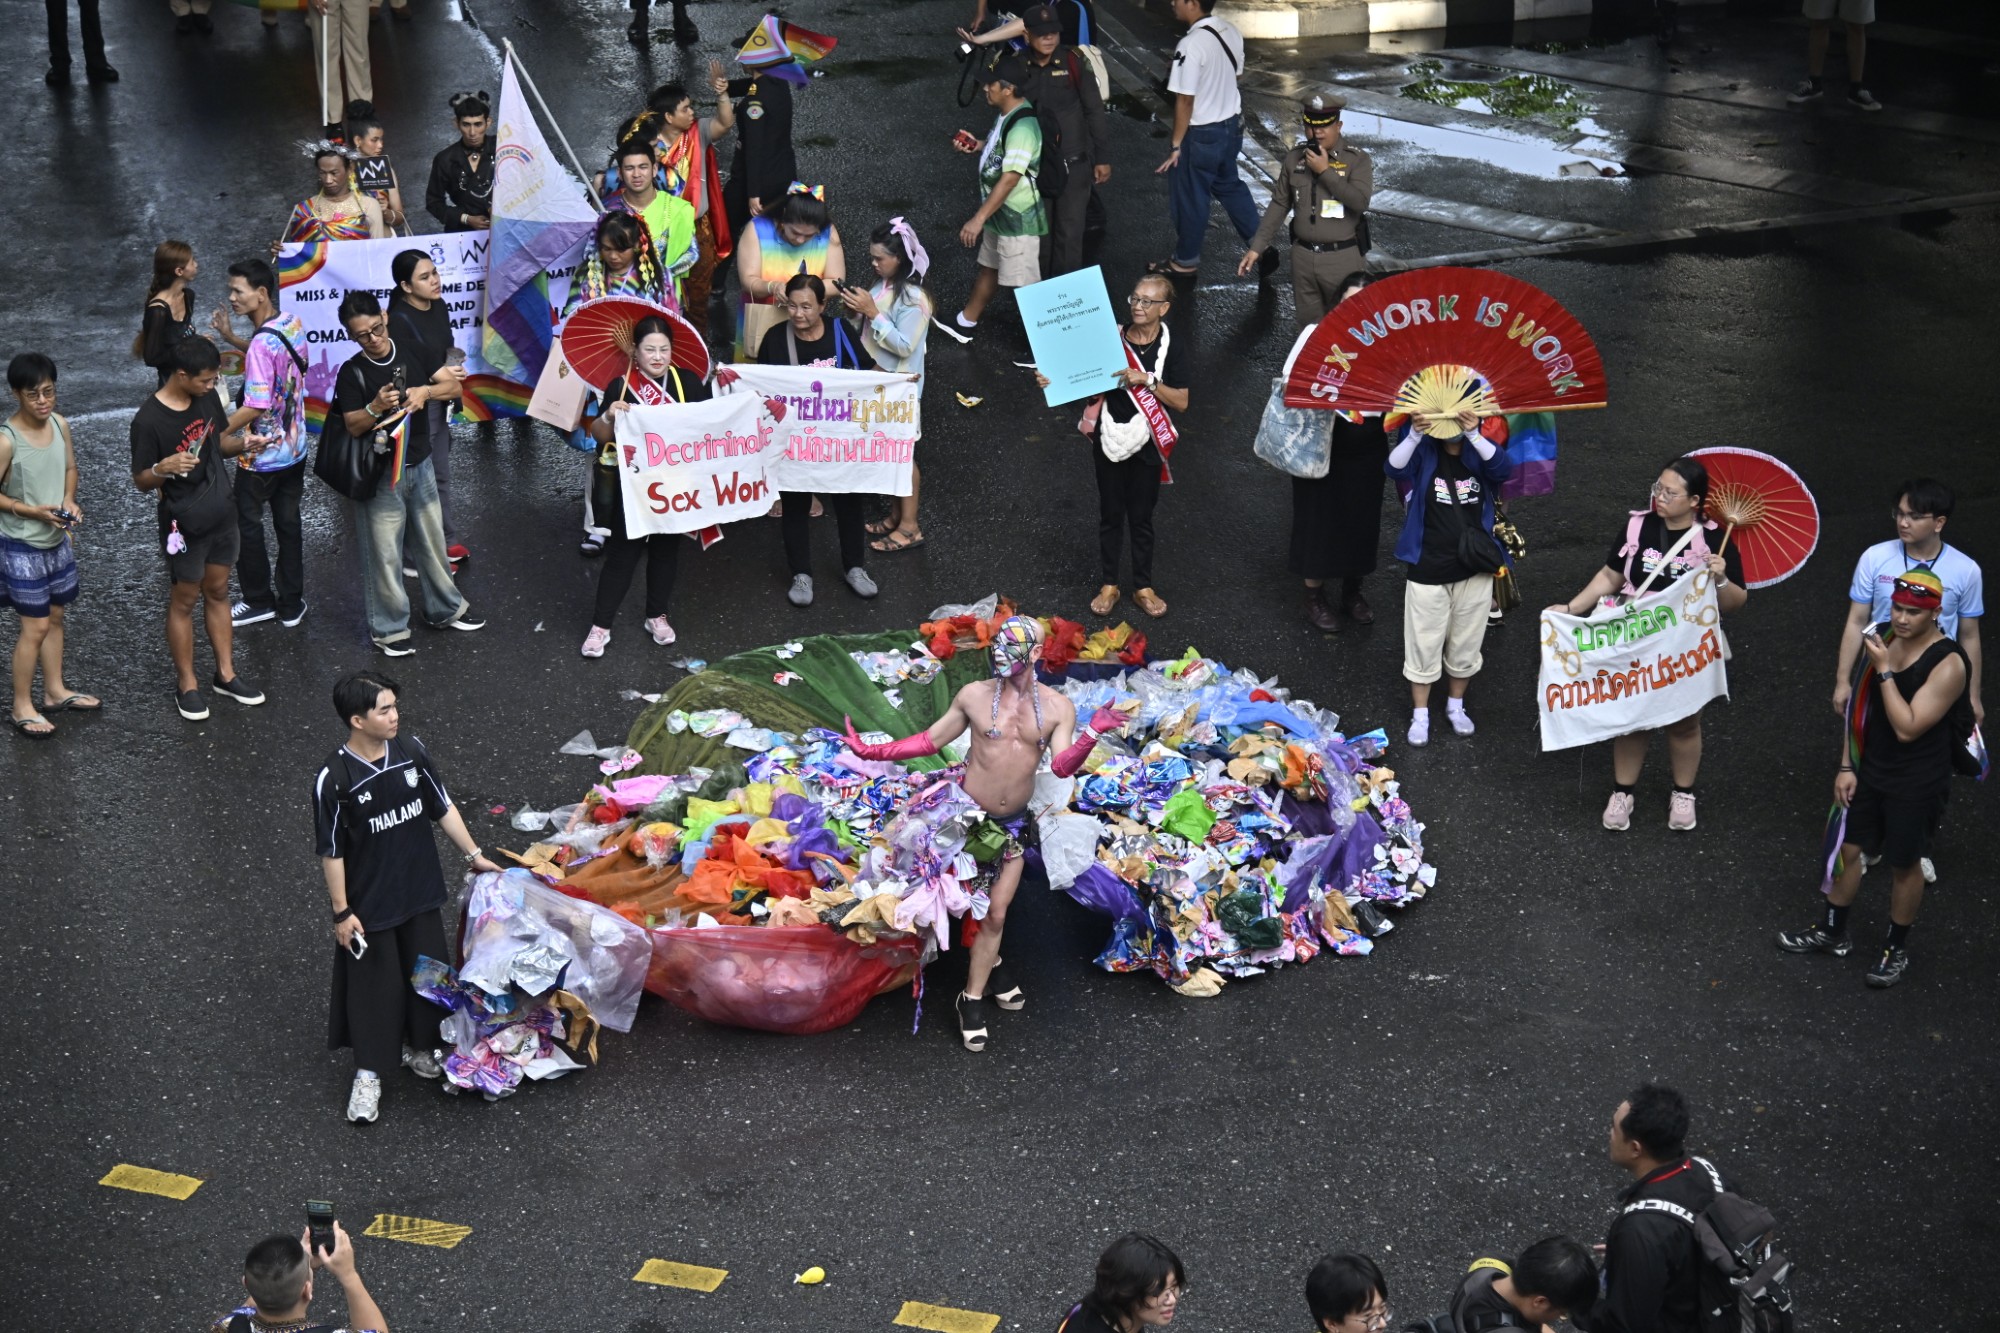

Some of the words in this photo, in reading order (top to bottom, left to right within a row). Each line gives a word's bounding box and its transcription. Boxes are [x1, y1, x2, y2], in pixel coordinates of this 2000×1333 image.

[296, 289, 325, 302] MISS
[329, 288, 339, 299] &
[442, 283, 462, 294] ME
[466, 280, 485, 292] DE
[546, 266, 577, 280] NATI
[447, 301, 475, 312] AND
[306, 329, 350, 343] OMA
[1310, 344, 1358, 402] SEX
[1349, 294, 1460, 346] WORK
[1474, 296, 1508, 328] IS
[1507, 312, 1584, 396] WORK
[1136, 387, 1158, 417] WORK
[1152, 414, 1162, 425] IS
[647, 481, 701, 514] Sex
[1572, 603, 1677, 652] ปลดล็อค
[1546, 628, 1722, 712] ความผิดค้าประเวณี
[368, 798, 423, 834] THAILAND
